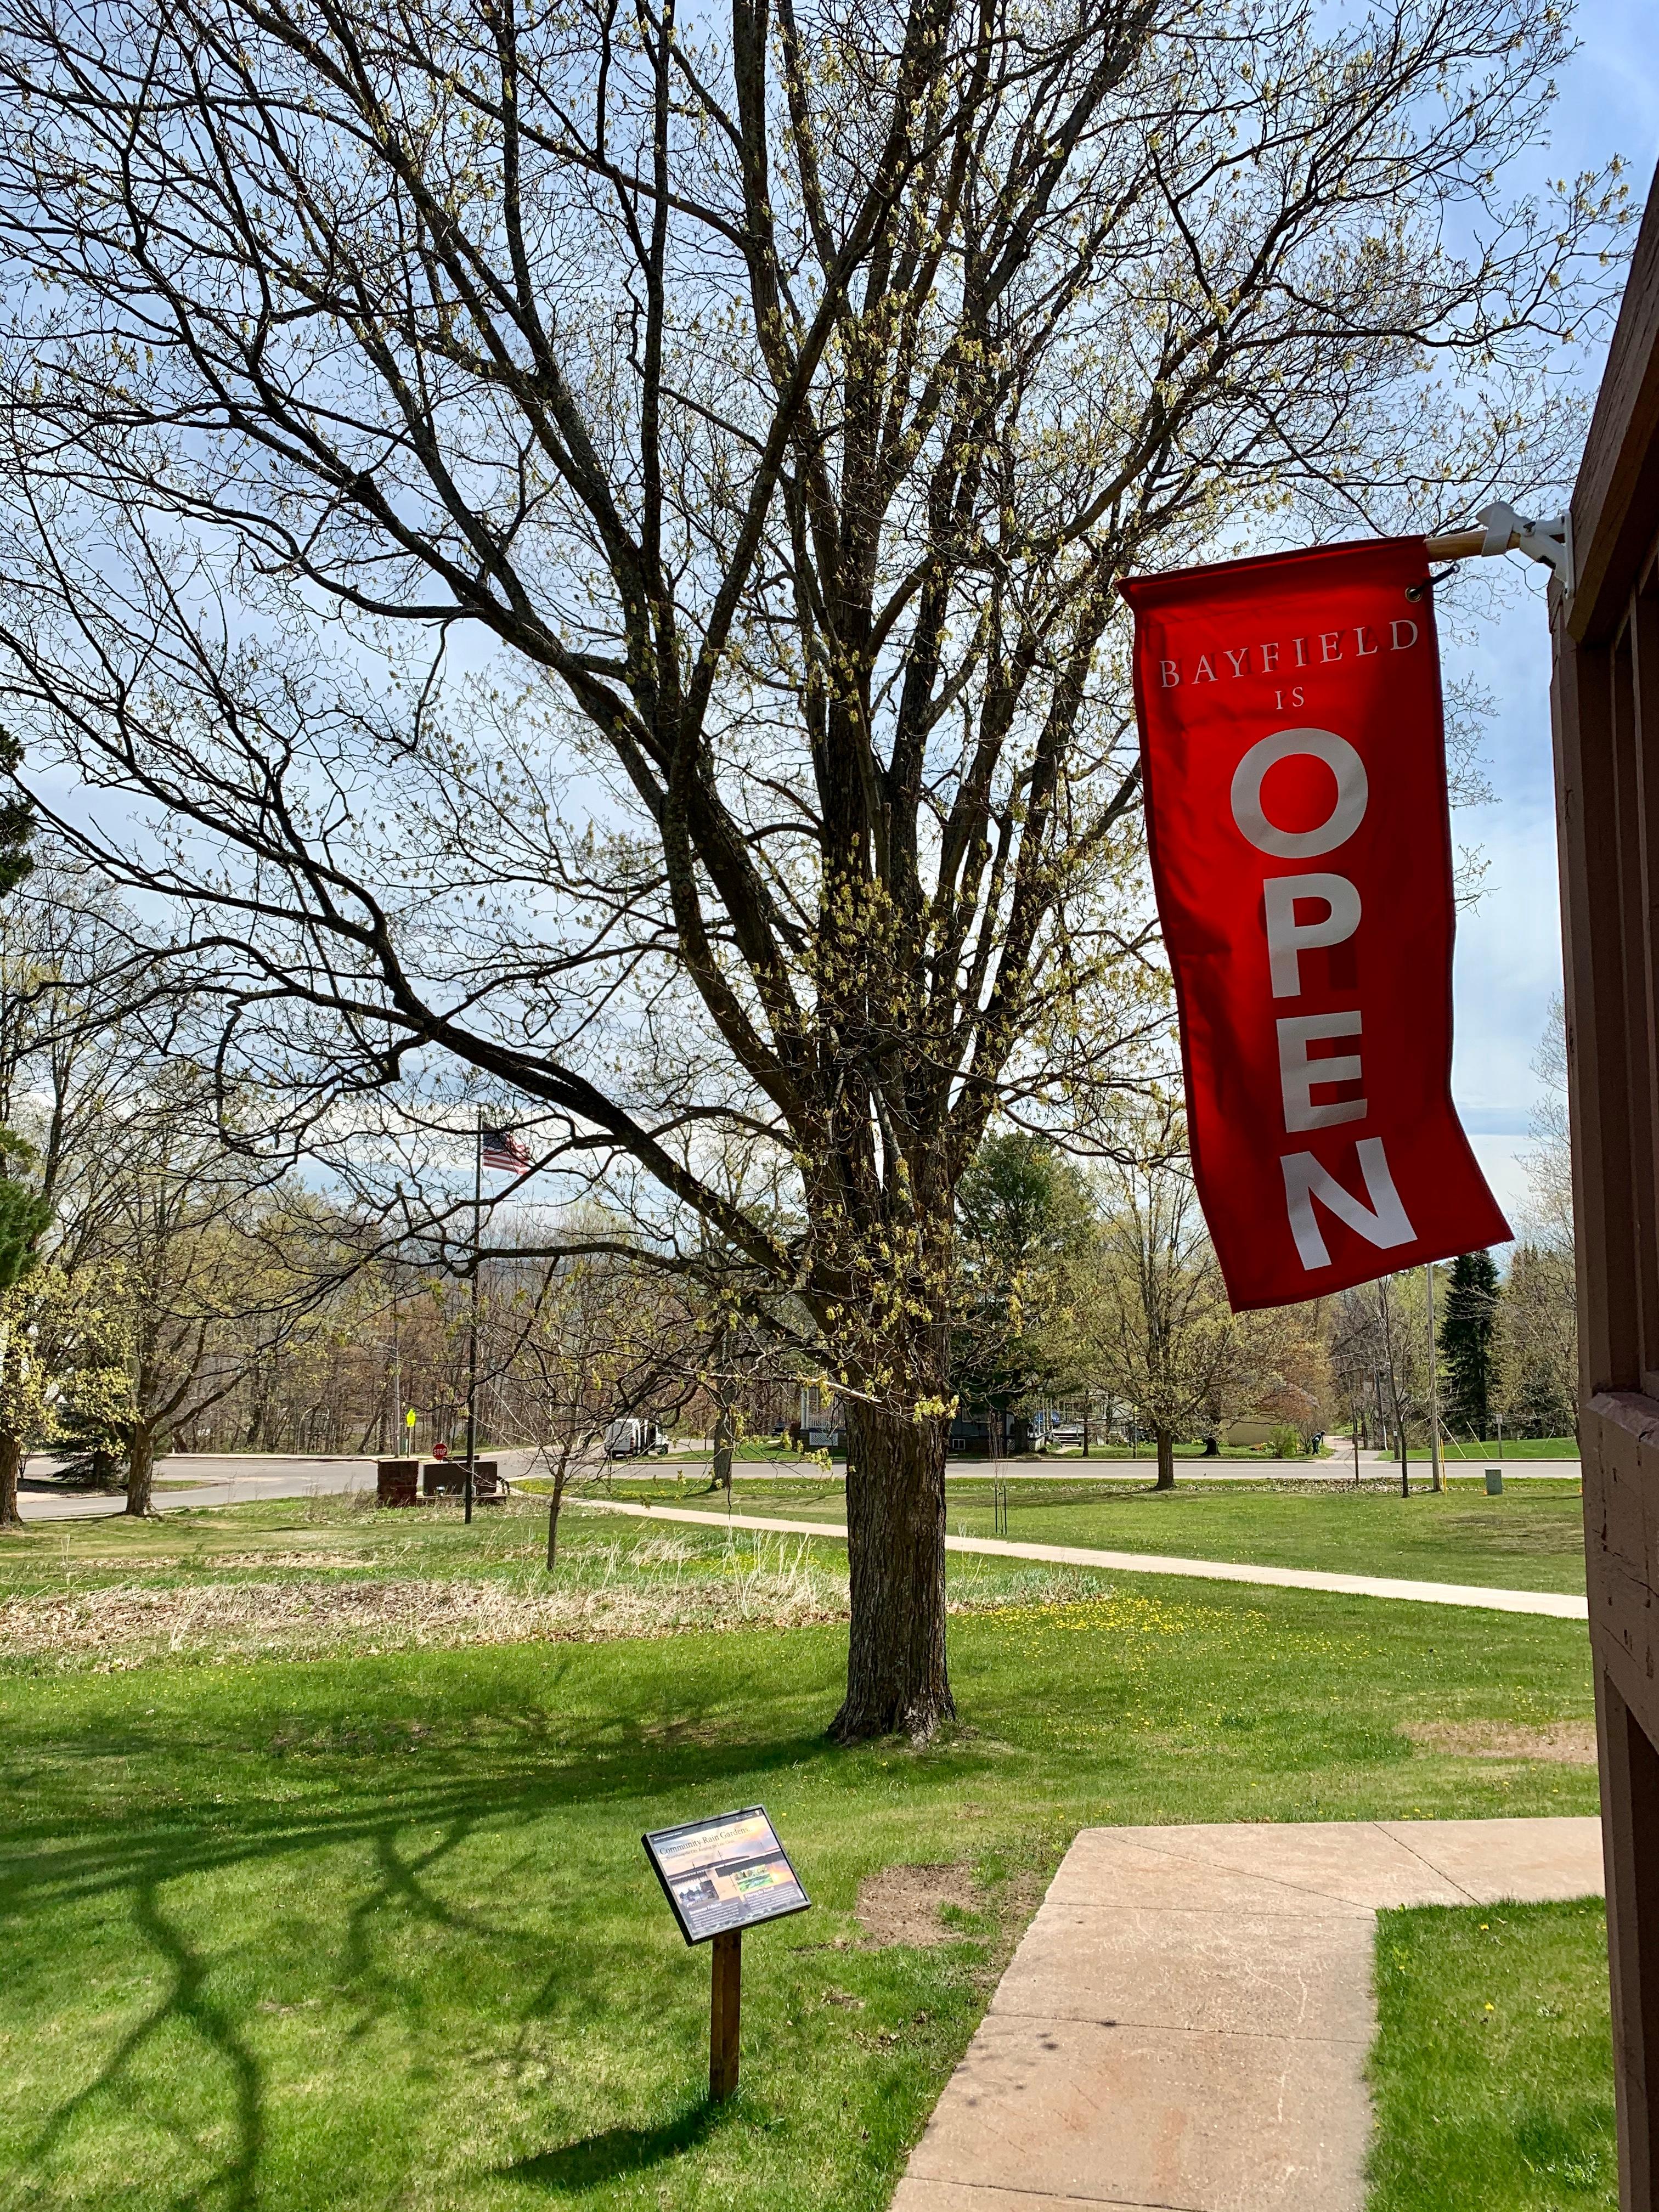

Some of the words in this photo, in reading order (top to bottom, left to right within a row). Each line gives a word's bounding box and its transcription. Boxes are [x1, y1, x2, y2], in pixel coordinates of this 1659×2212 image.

[1159, 619, 1418, 688] BAYFIELD
[1274, 686, 1305, 710] IS
[1231, 727, 1418, 1271] OPEN
[659, 1839, 701, 1855] Community
[702, 1835, 720, 1844] Rain
